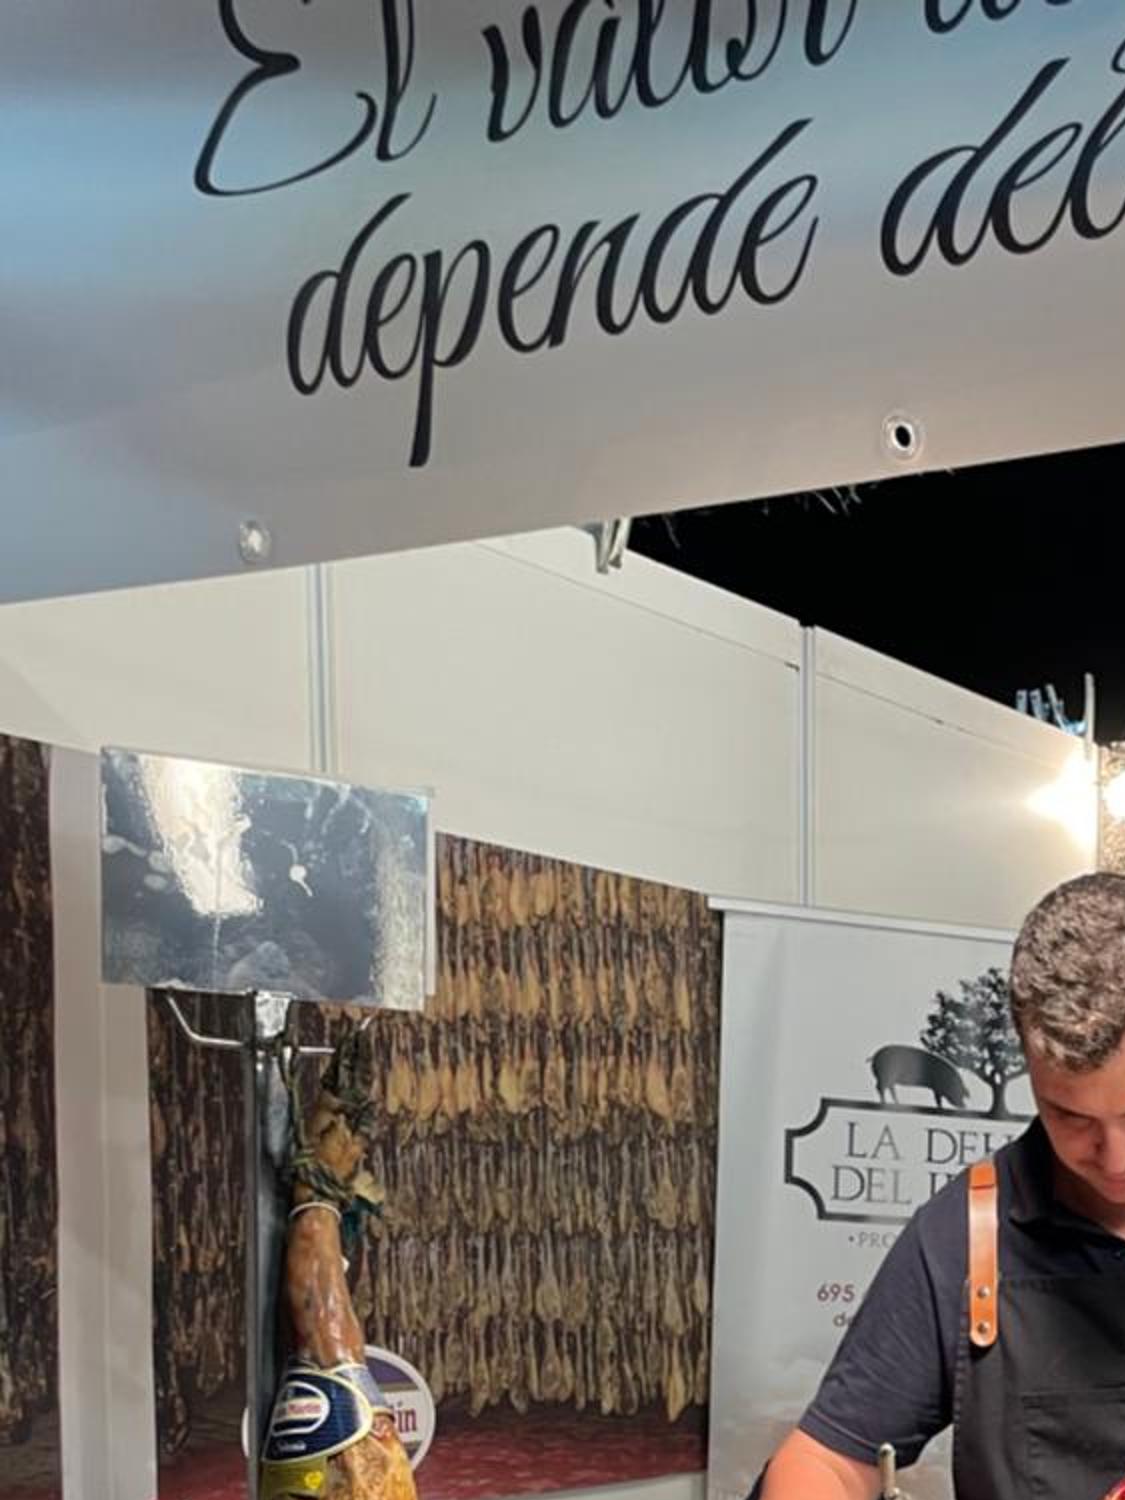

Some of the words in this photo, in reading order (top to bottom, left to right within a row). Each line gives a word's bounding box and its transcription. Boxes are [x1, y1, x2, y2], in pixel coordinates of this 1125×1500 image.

[287, 118, 820, 467] depende
[844, 1121, 900, 1161] LA
[831, 1164, 913, 1205] DEL
[816, 1283, 856, 1303] 695
